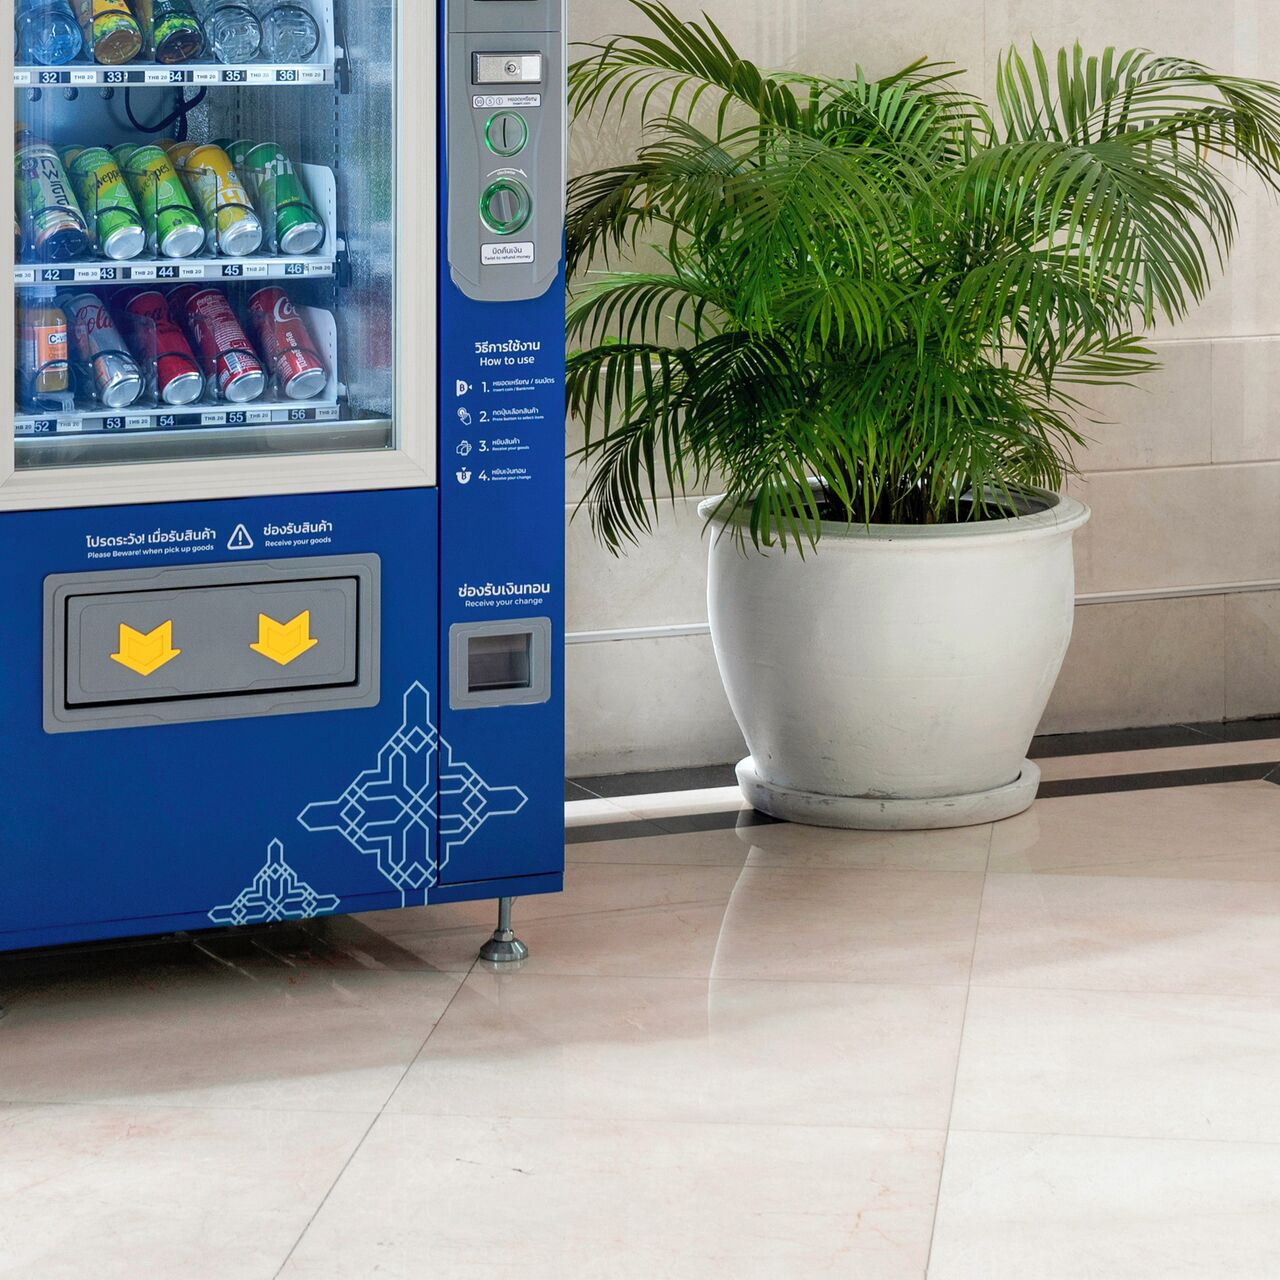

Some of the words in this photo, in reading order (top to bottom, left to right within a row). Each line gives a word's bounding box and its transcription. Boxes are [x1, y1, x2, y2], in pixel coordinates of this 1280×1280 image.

[42, 71, 57, 83] 32
[107, 71, 122, 82] 33
[226, 70, 241, 81] 35
[279, 70, 294, 81] 36
[100, 268, 114, 279] 43
[158, 267, 173, 277] 44
[224, 265, 239, 275] 45
[287, 263, 302, 274] 46
[44, 269, 60, 280] 42
[474, 340, 540, 354] วิธีการใช้งาน
[480, 357, 502, 366] How
[504, 356, 515, 365] to
[517, 355, 535, 364] use
[160, 415, 175, 426] 54
[229, 412, 244, 422] 55
[291, 410, 306, 420] 56
[479, 411, 490, 422] 2.
[35, 421, 49, 432] 52
[106, 418, 121, 428] 53
[479, 440, 490, 452] 3.
[478, 470, 490, 481] 4.
[263, 519, 333, 536] ช่องรับสินค้า
[86, 533, 145, 548] โปรดระวัง!
[148, 527, 217, 543] เมื่อรับสินค้า
[265, 539, 292, 547] Receive
[293, 539, 309, 547] your
[309, 537, 332, 546] goods
[87, 551, 111, 559] Please
[112, 549, 141, 558] Beware!
[164, 546, 180, 554] pick
[192, 544, 215, 552] goods
[458, 582, 550, 598] ช่องรับเงินทอน
[465, 599, 495, 608] Receive
[495, 599, 513, 608] your
[514, 597, 543, 606] change
